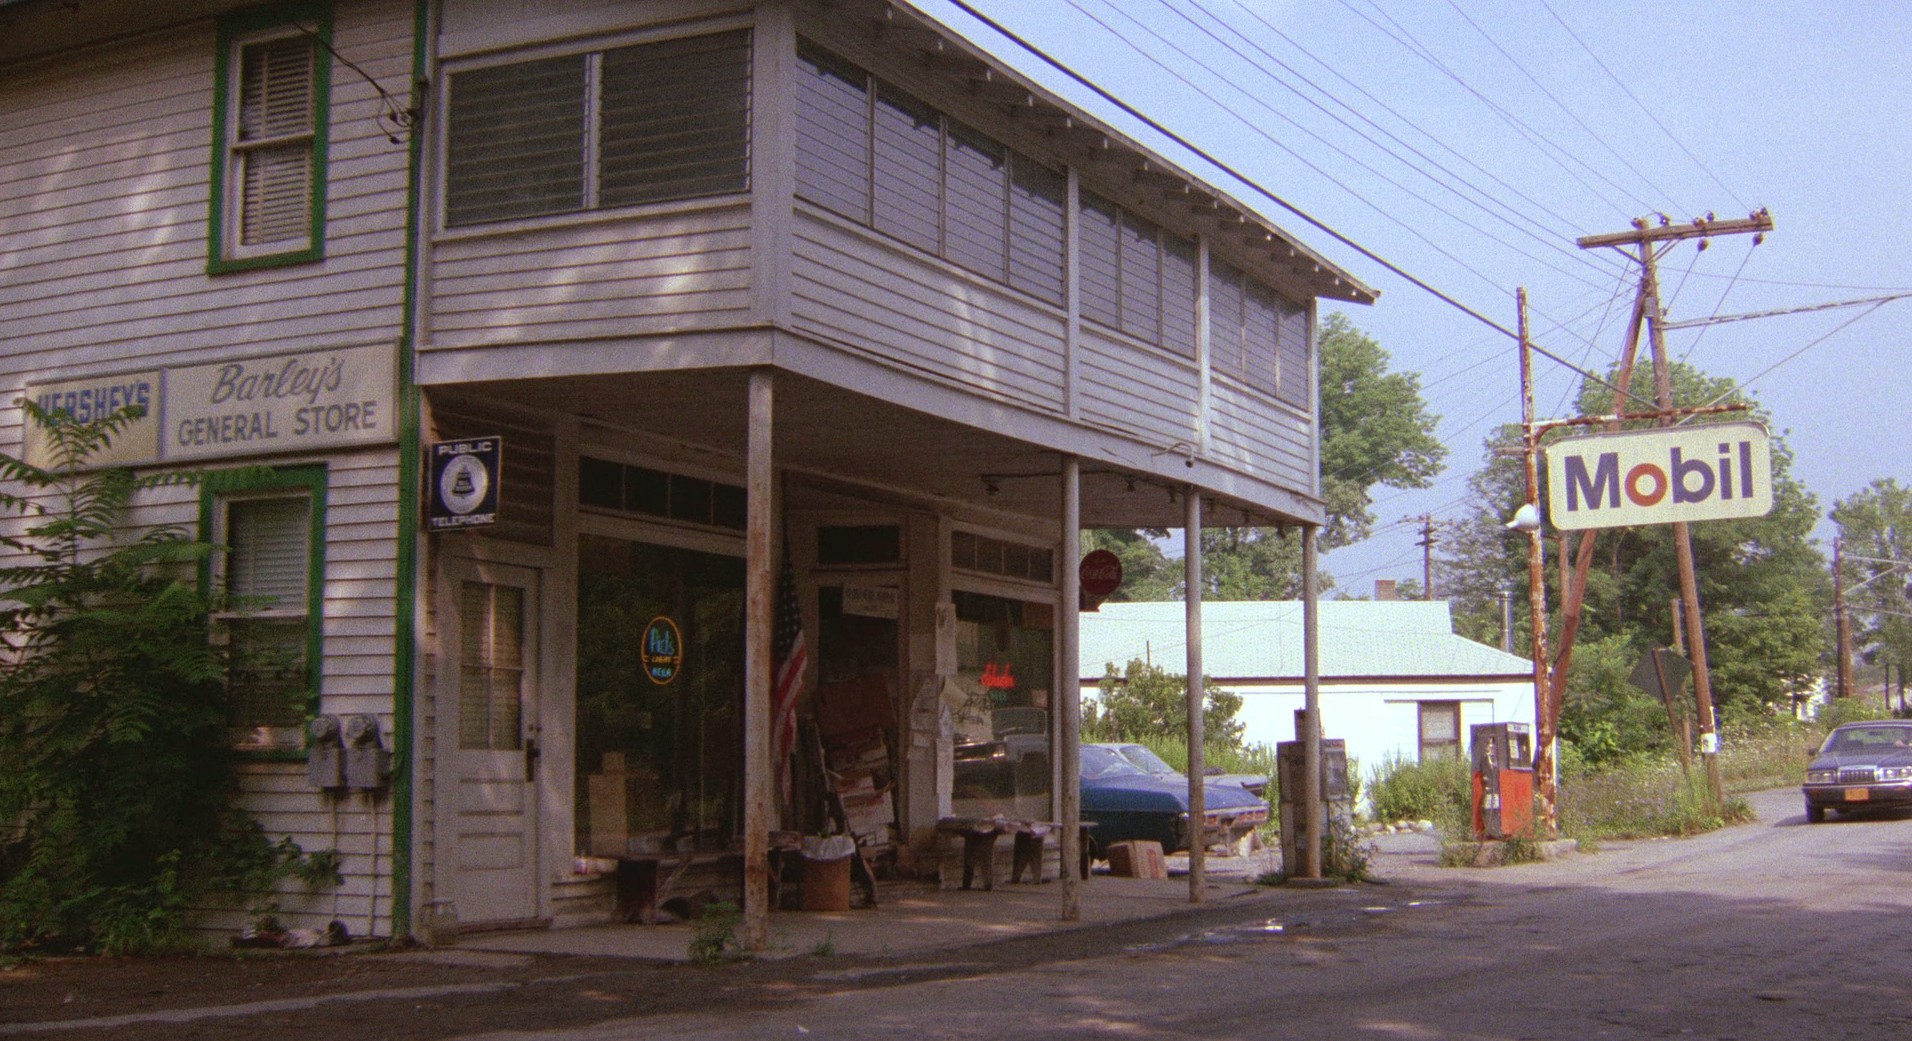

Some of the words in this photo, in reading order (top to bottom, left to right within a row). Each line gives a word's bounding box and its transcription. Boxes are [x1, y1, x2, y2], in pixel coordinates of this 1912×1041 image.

[211, 357, 345, 404] Barley's
[178, 411, 278, 446] GENERAL
[294, 400, 378, 435] STORE
[438, 441, 493, 455] PUBLIC
[1564, 441, 1754, 512] Mobil
[432, 513, 496, 527] TELEPHONE
